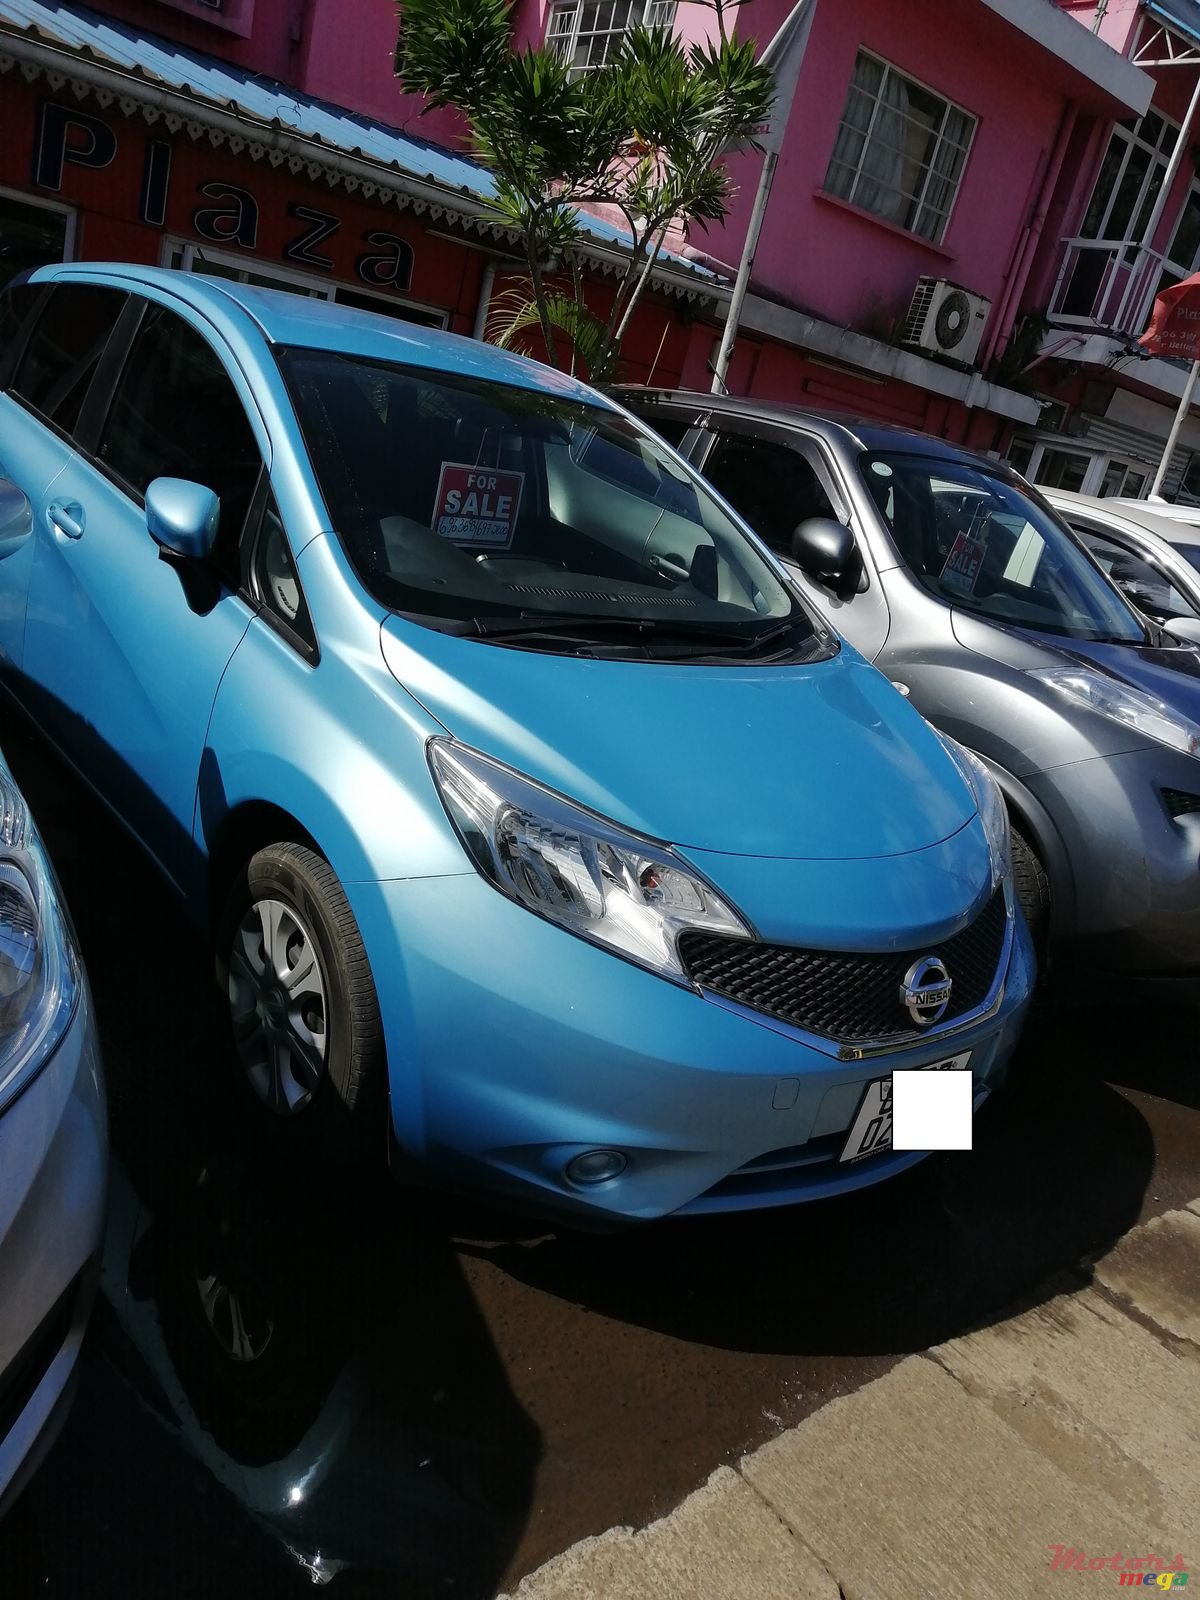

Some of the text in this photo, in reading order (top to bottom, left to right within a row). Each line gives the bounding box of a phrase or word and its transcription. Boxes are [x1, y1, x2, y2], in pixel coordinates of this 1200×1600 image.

[34, 102, 415, 291] Plaza
[1177, 307, 1200, 320] Pla
[467, 474, 497, 490] FOR
[444, 489, 513, 519] SALE
[949, 551, 977, 576] SALE
